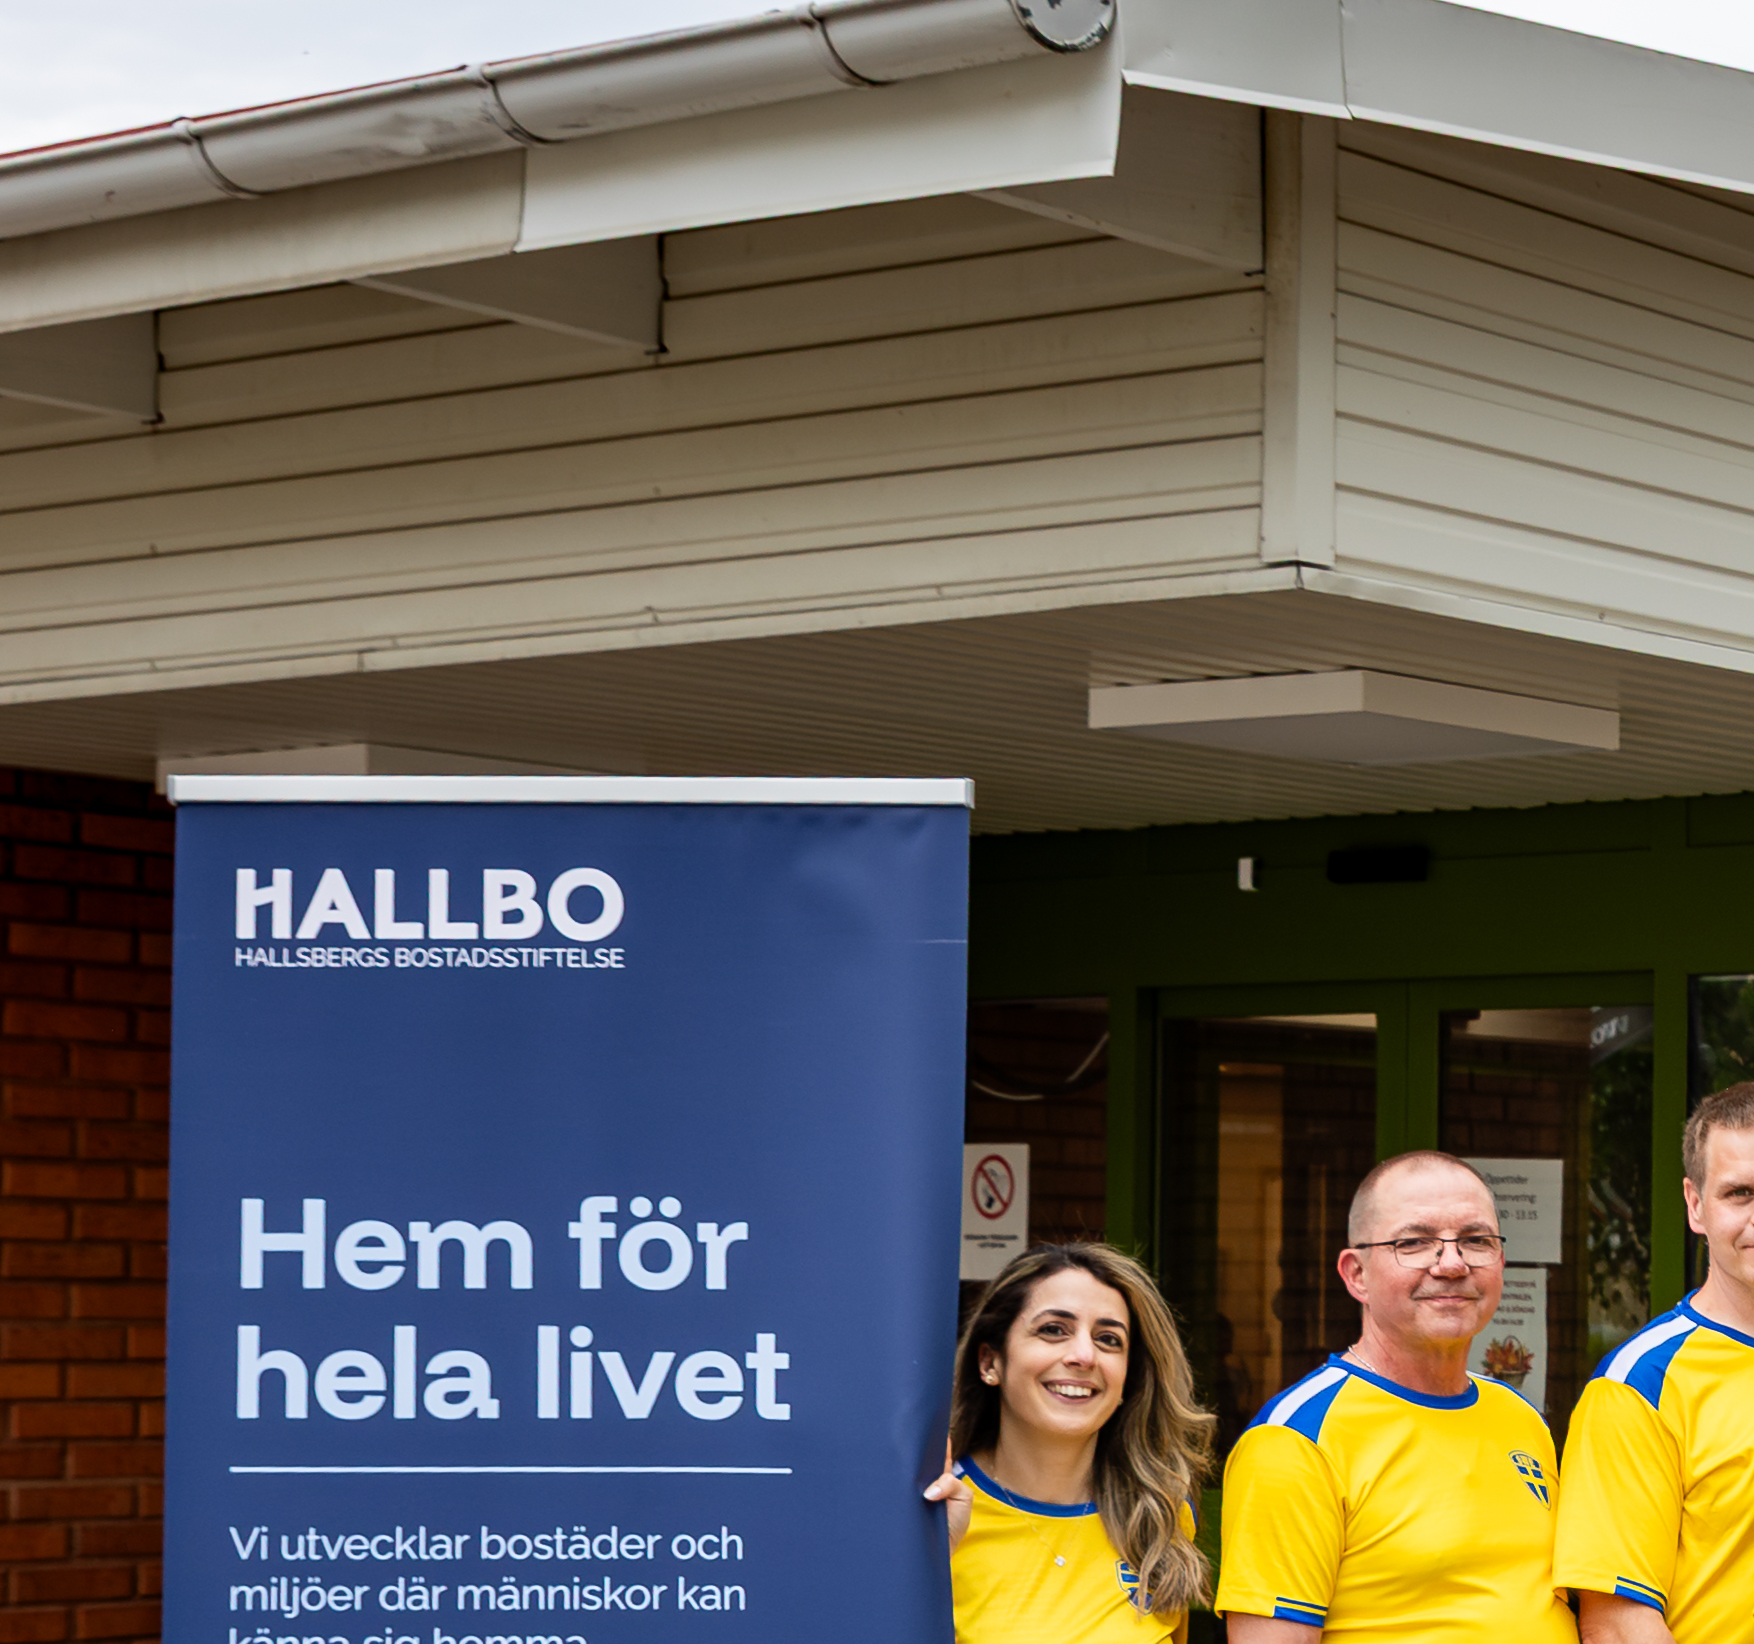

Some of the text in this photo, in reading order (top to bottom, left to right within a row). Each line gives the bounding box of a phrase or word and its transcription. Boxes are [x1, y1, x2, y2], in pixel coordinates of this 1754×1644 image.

[235, 867, 625, 942] HALLBO
[235, 947, 626, 969] HALLSBERGS BOSTADSSTIFTELSE
[240, 1196, 748, 1291] Hem för
[236, 1325, 791, 1421] hela livet
[229, 1525, 743, 1560] Vi utvecklar bostäder och
[230, 1576, 746, 1619] miljöer där människor kan
